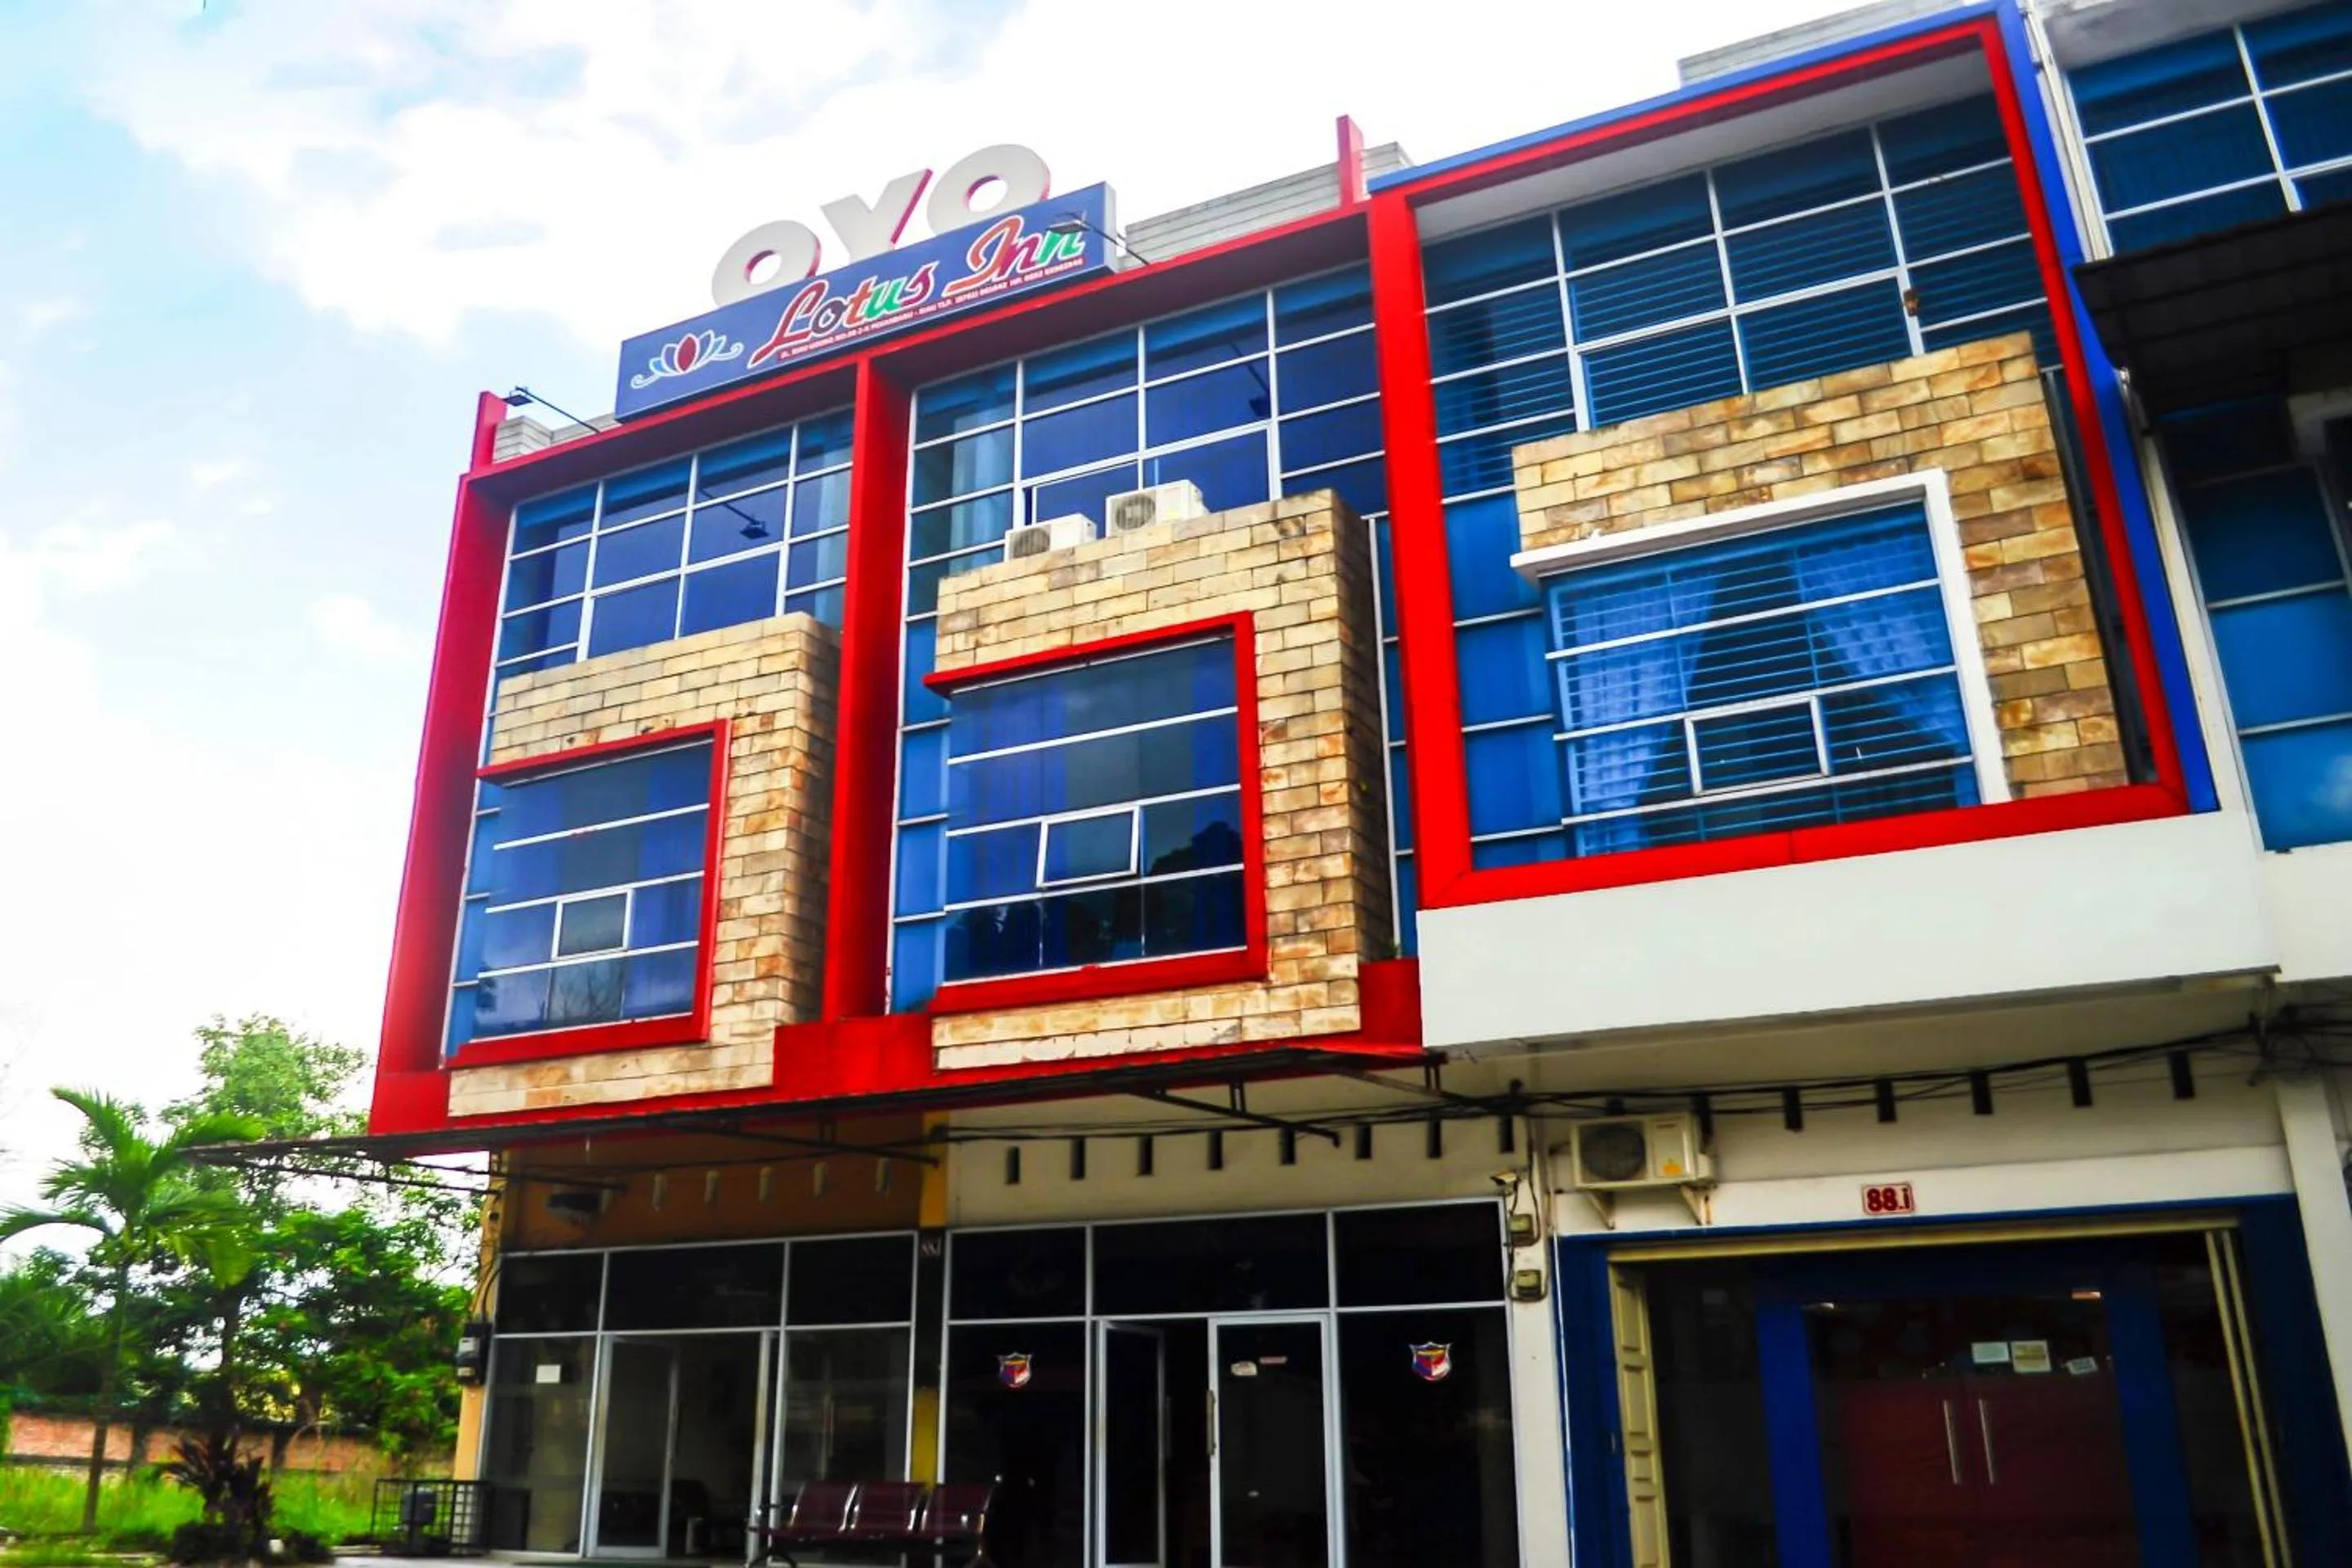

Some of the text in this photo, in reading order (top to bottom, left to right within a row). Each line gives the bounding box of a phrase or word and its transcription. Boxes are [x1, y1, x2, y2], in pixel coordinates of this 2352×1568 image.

[711, 144, 1050, 307] OYO
[747, 214, 1086, 368] Lotus Inn
